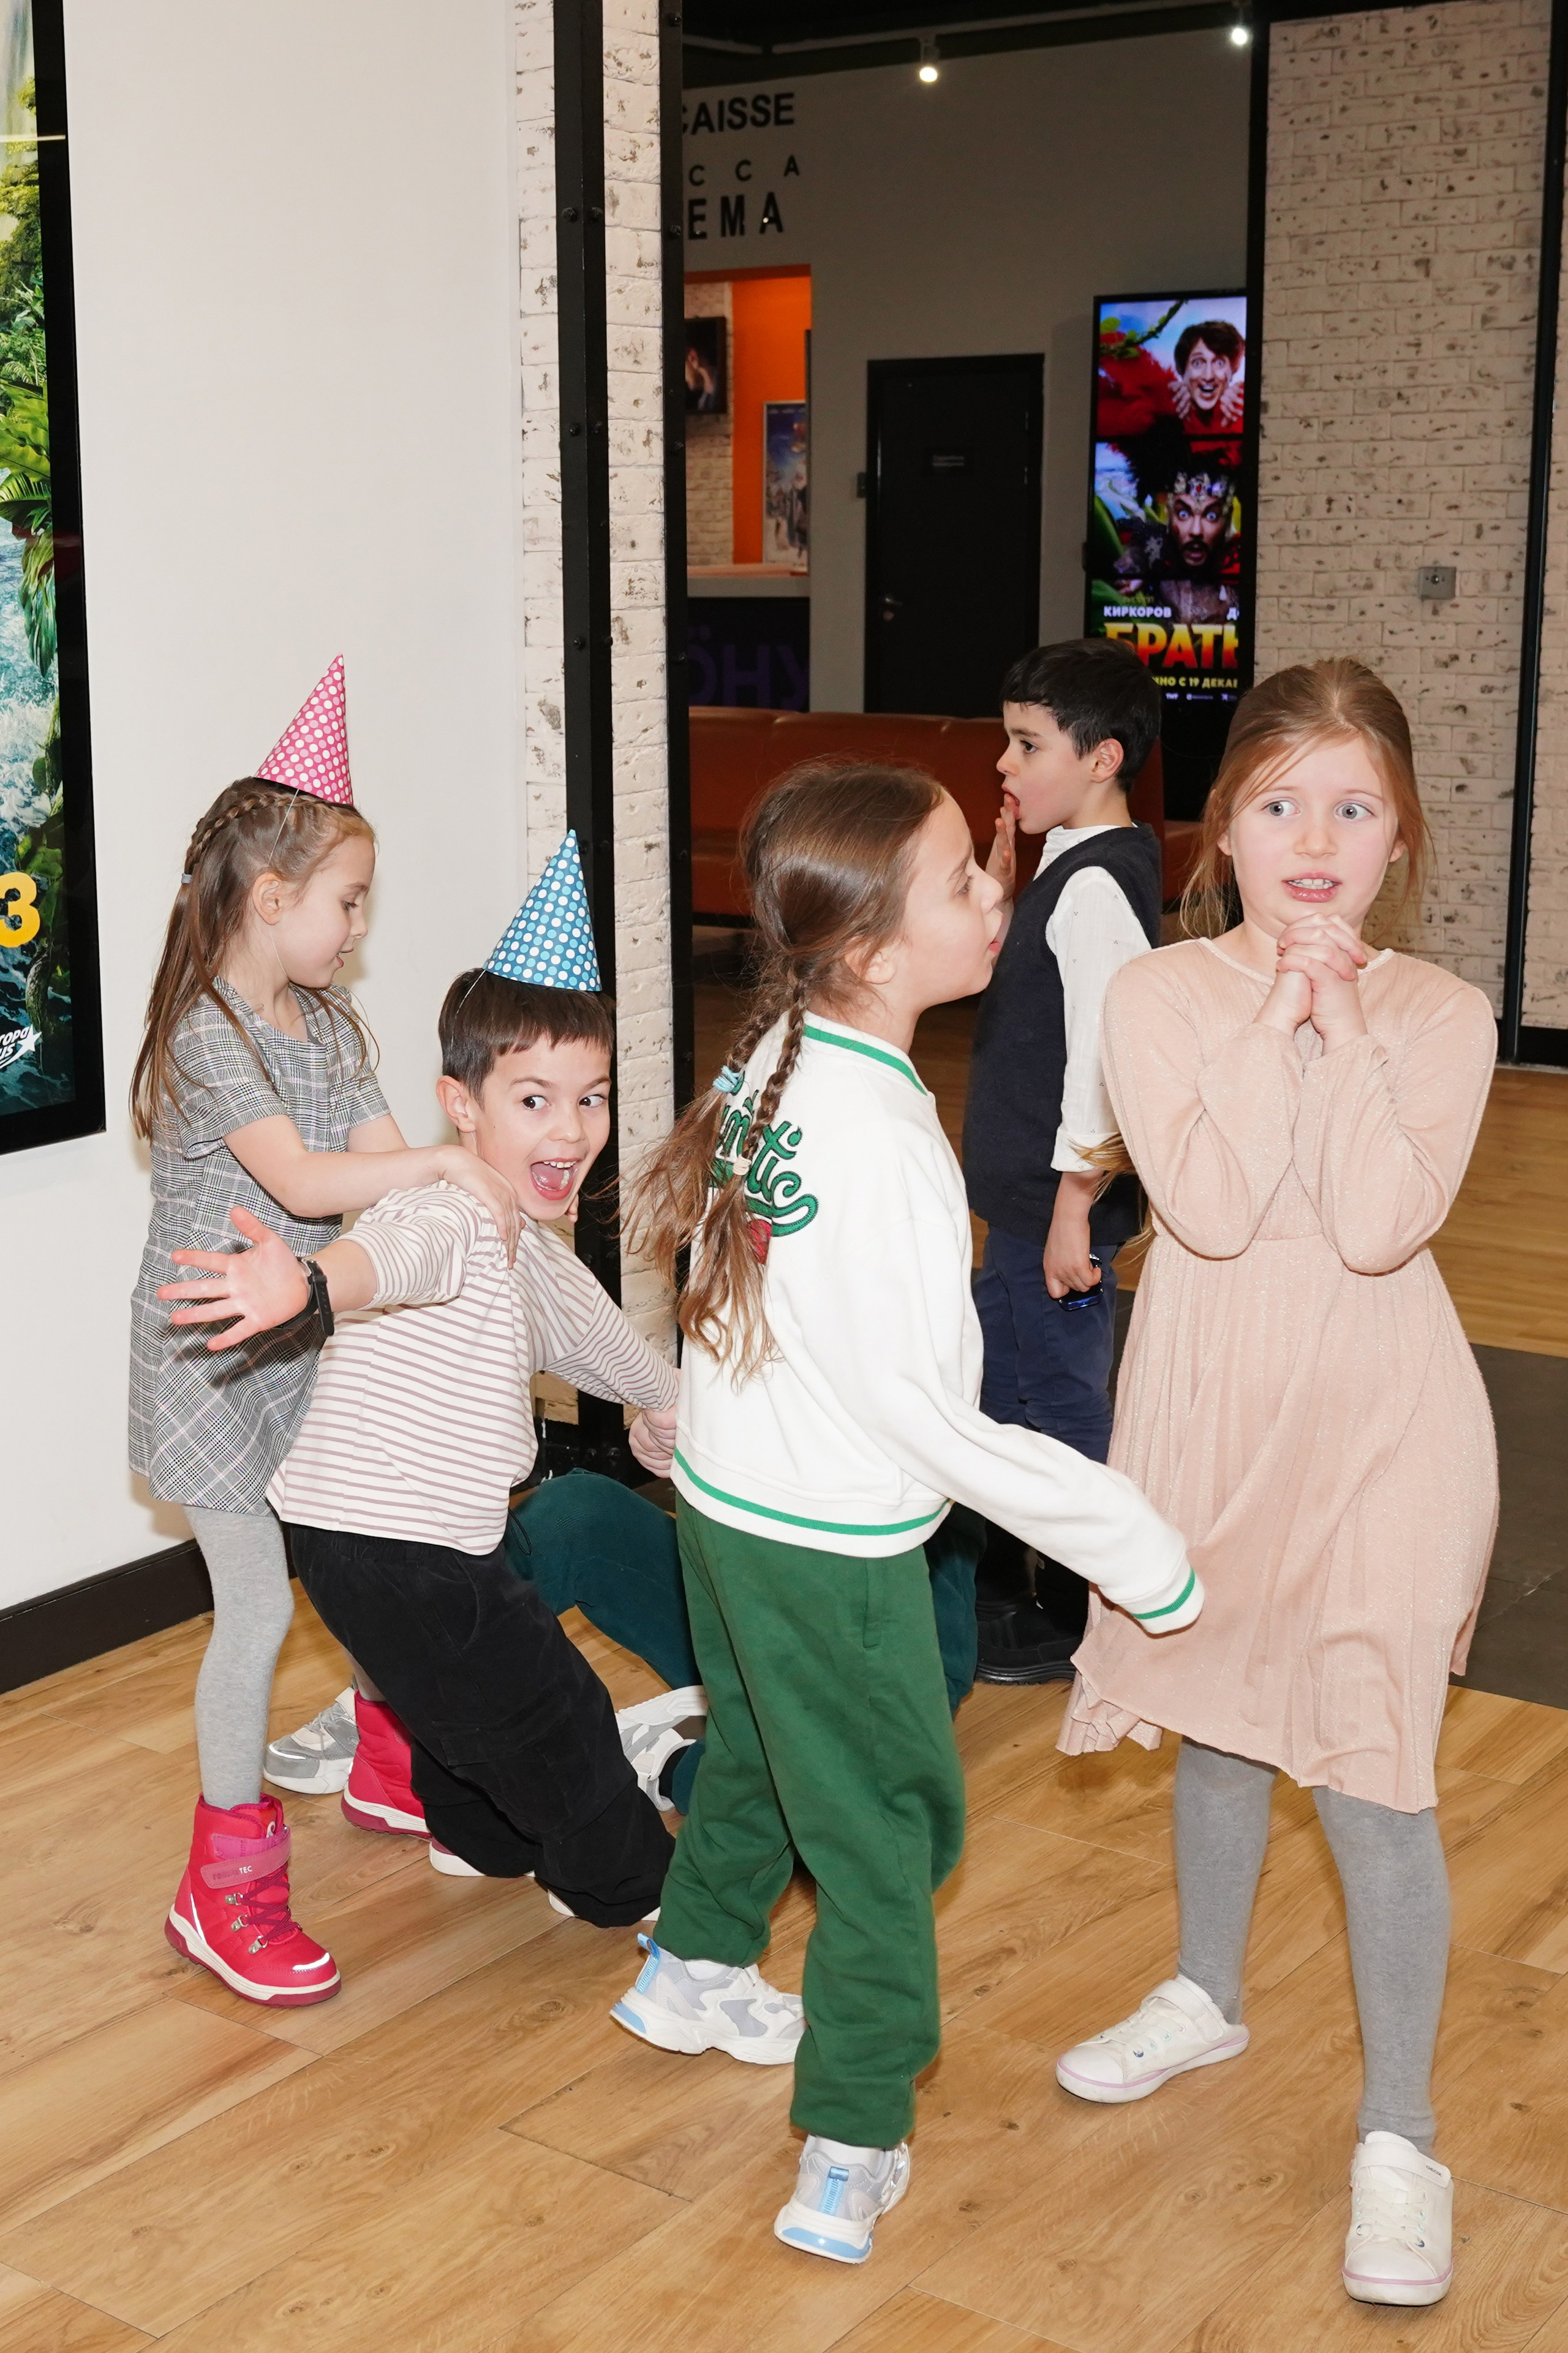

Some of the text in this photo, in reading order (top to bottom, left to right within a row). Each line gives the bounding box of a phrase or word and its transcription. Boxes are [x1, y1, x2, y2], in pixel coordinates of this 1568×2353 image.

[682, 93, 794, 135] AISSE
[1104, 605, 1172, 618] КИРКОРОВ
[1189, 676, 1200, 687] 19
[239, 1865, 252, 1874] TEC
